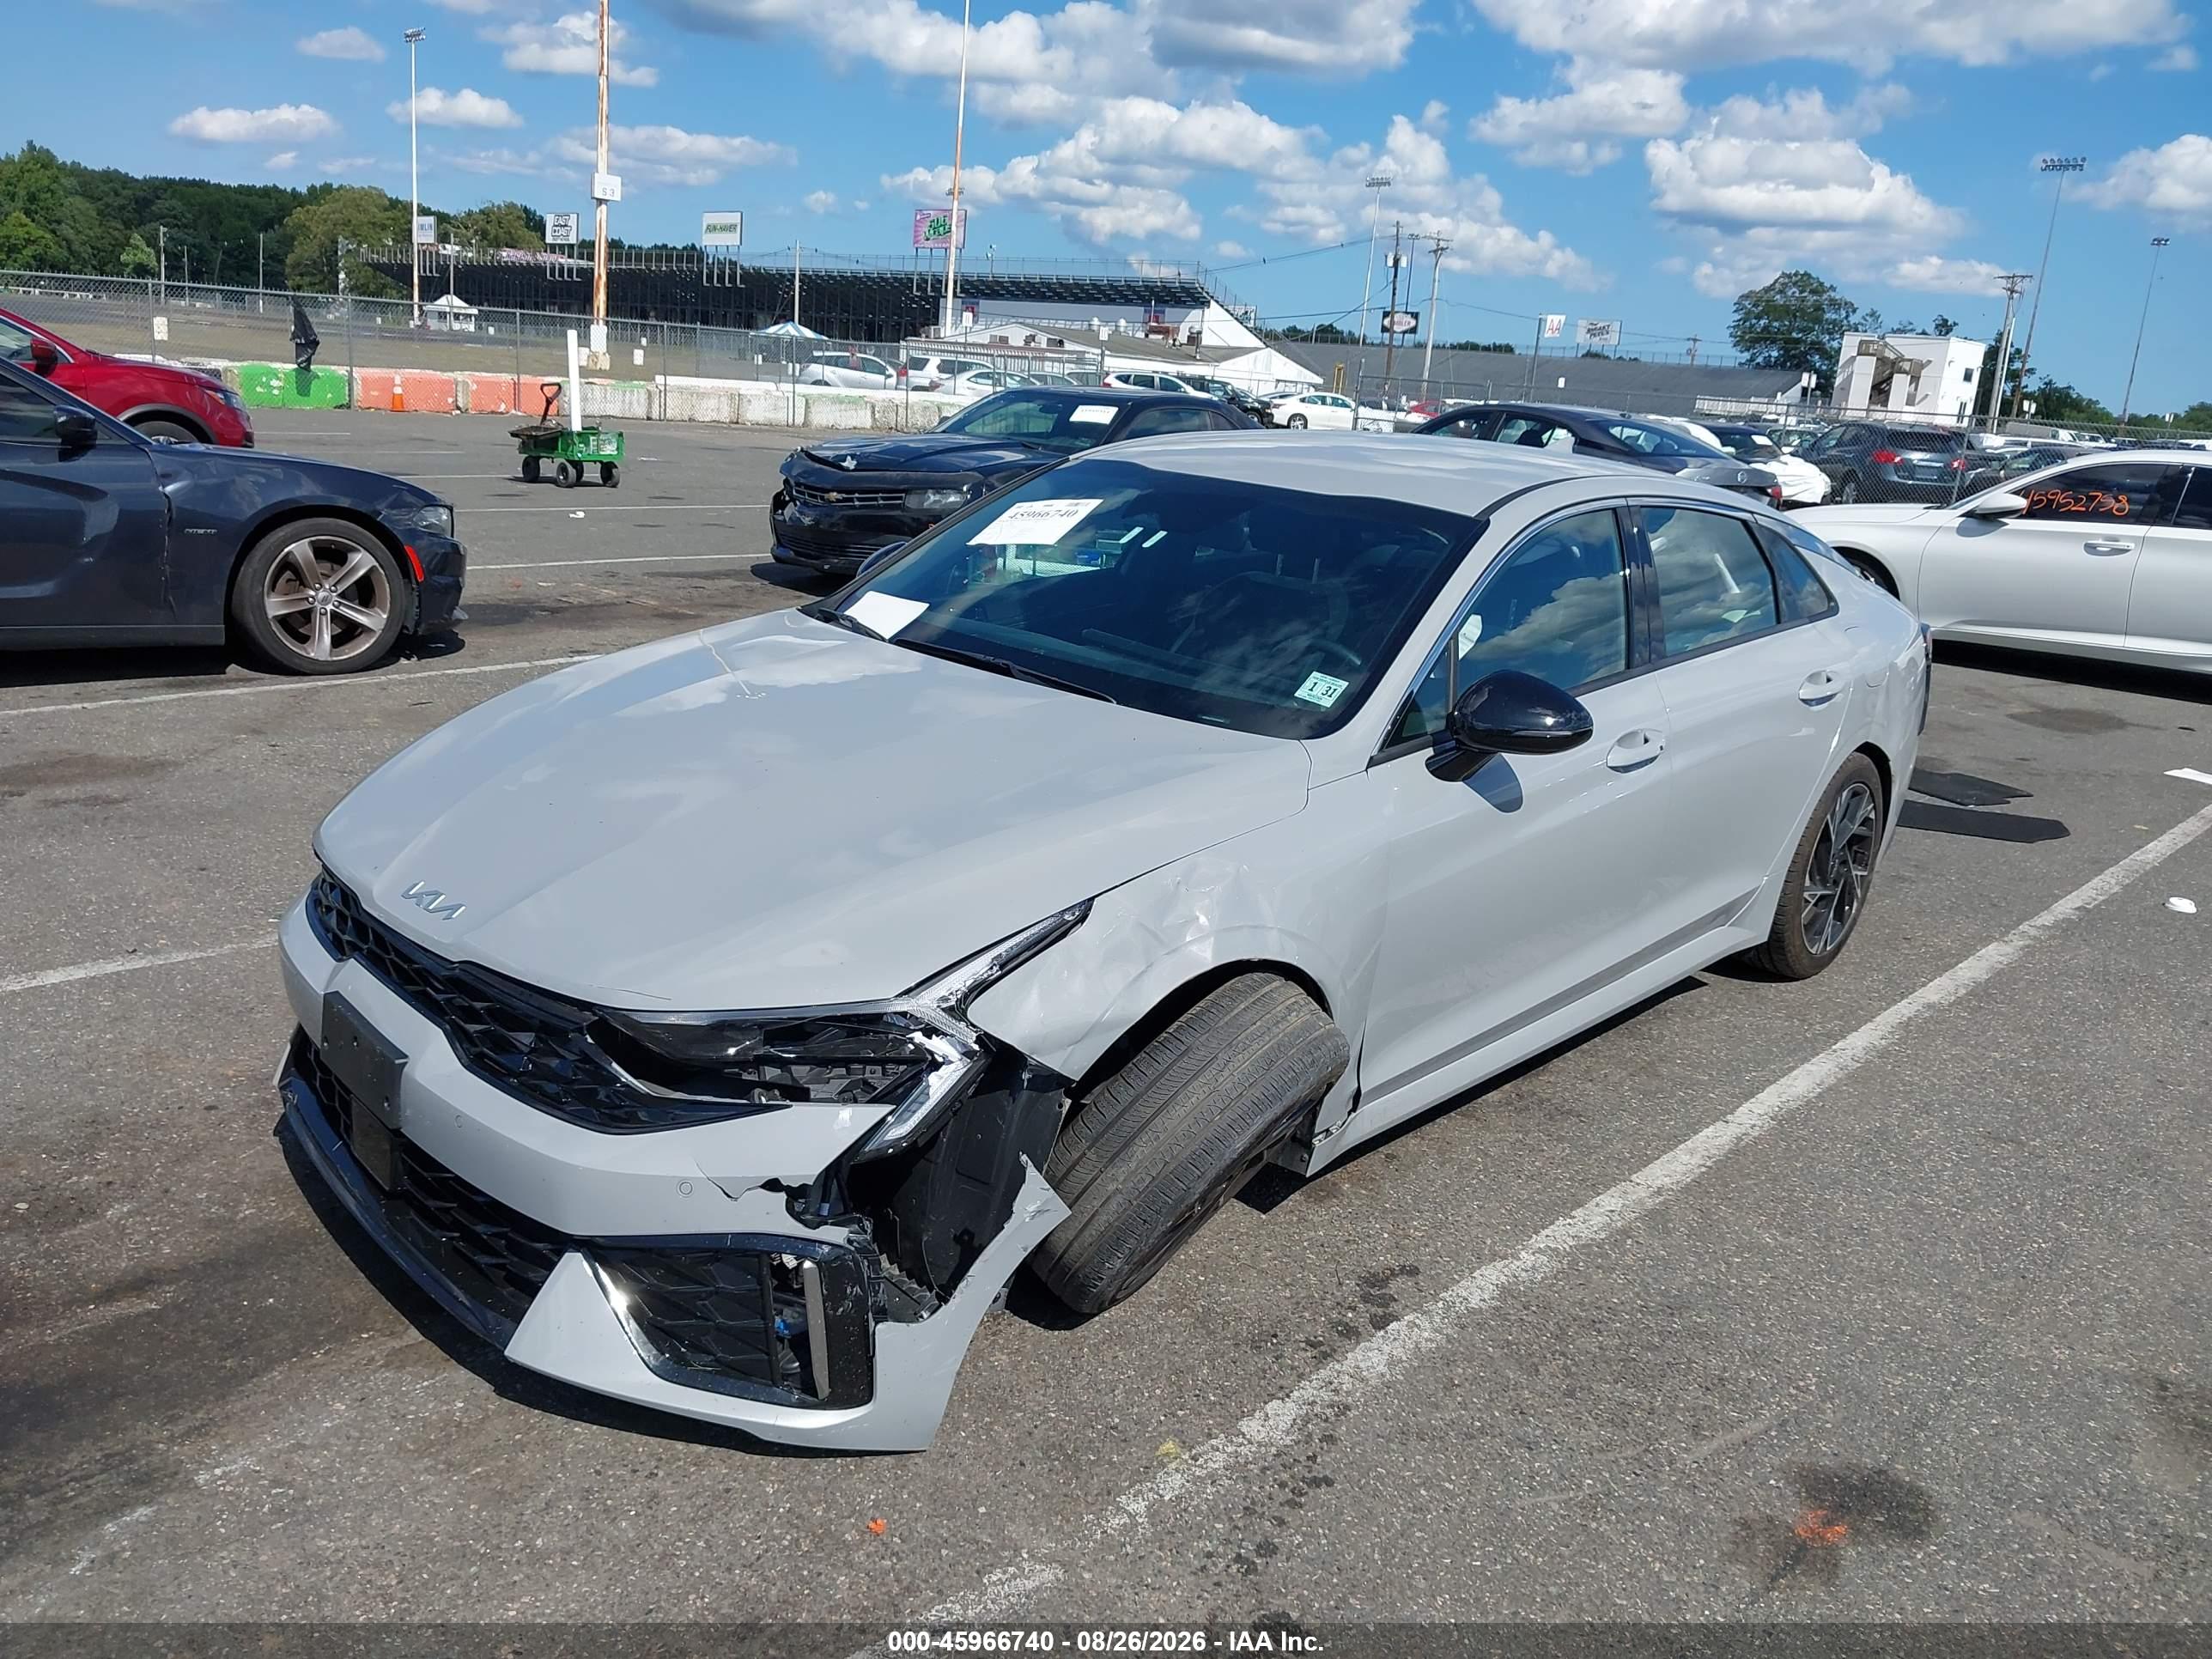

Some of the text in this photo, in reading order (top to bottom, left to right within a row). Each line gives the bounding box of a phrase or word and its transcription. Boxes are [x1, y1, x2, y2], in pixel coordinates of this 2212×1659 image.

[554, 215, 570, 226] EAST
[551, 225, 572, 237] COAST
[1008, 508, 1079, 520] 45966740
[1308, 681, 1319, 692] 1
[1321, 685, 1339, 698] 31
[400, 879, 466, 921] KIA
